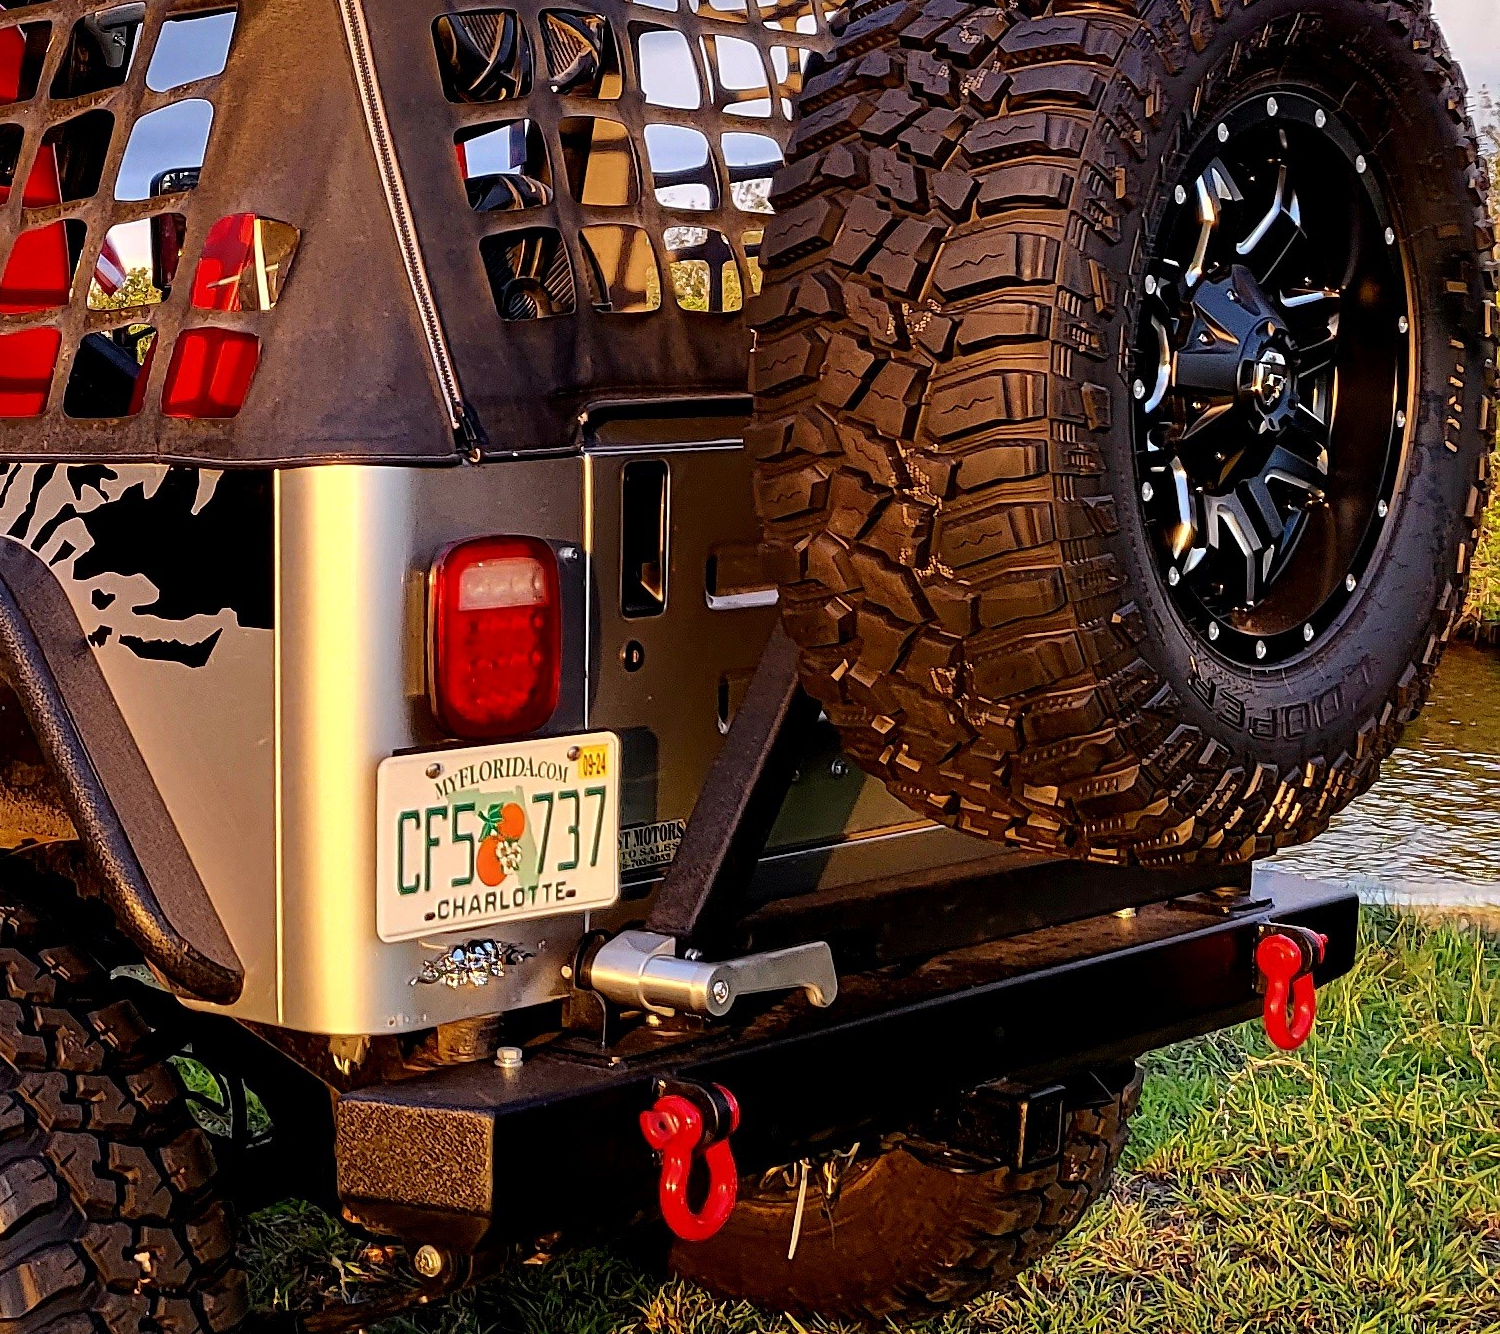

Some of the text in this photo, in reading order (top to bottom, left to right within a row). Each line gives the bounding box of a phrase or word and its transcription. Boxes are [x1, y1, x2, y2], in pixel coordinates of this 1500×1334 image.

[433, 755, 569, 800] MYFLORIDA.COM
[582, 751, 606, 777] 09-24
[531, 785, 607, 875] 737
[633, 820, 686, 848] MOTORS
[639, 840, 679, 857] SALES
[436, 880, 567, 921] CHARLOTTE
